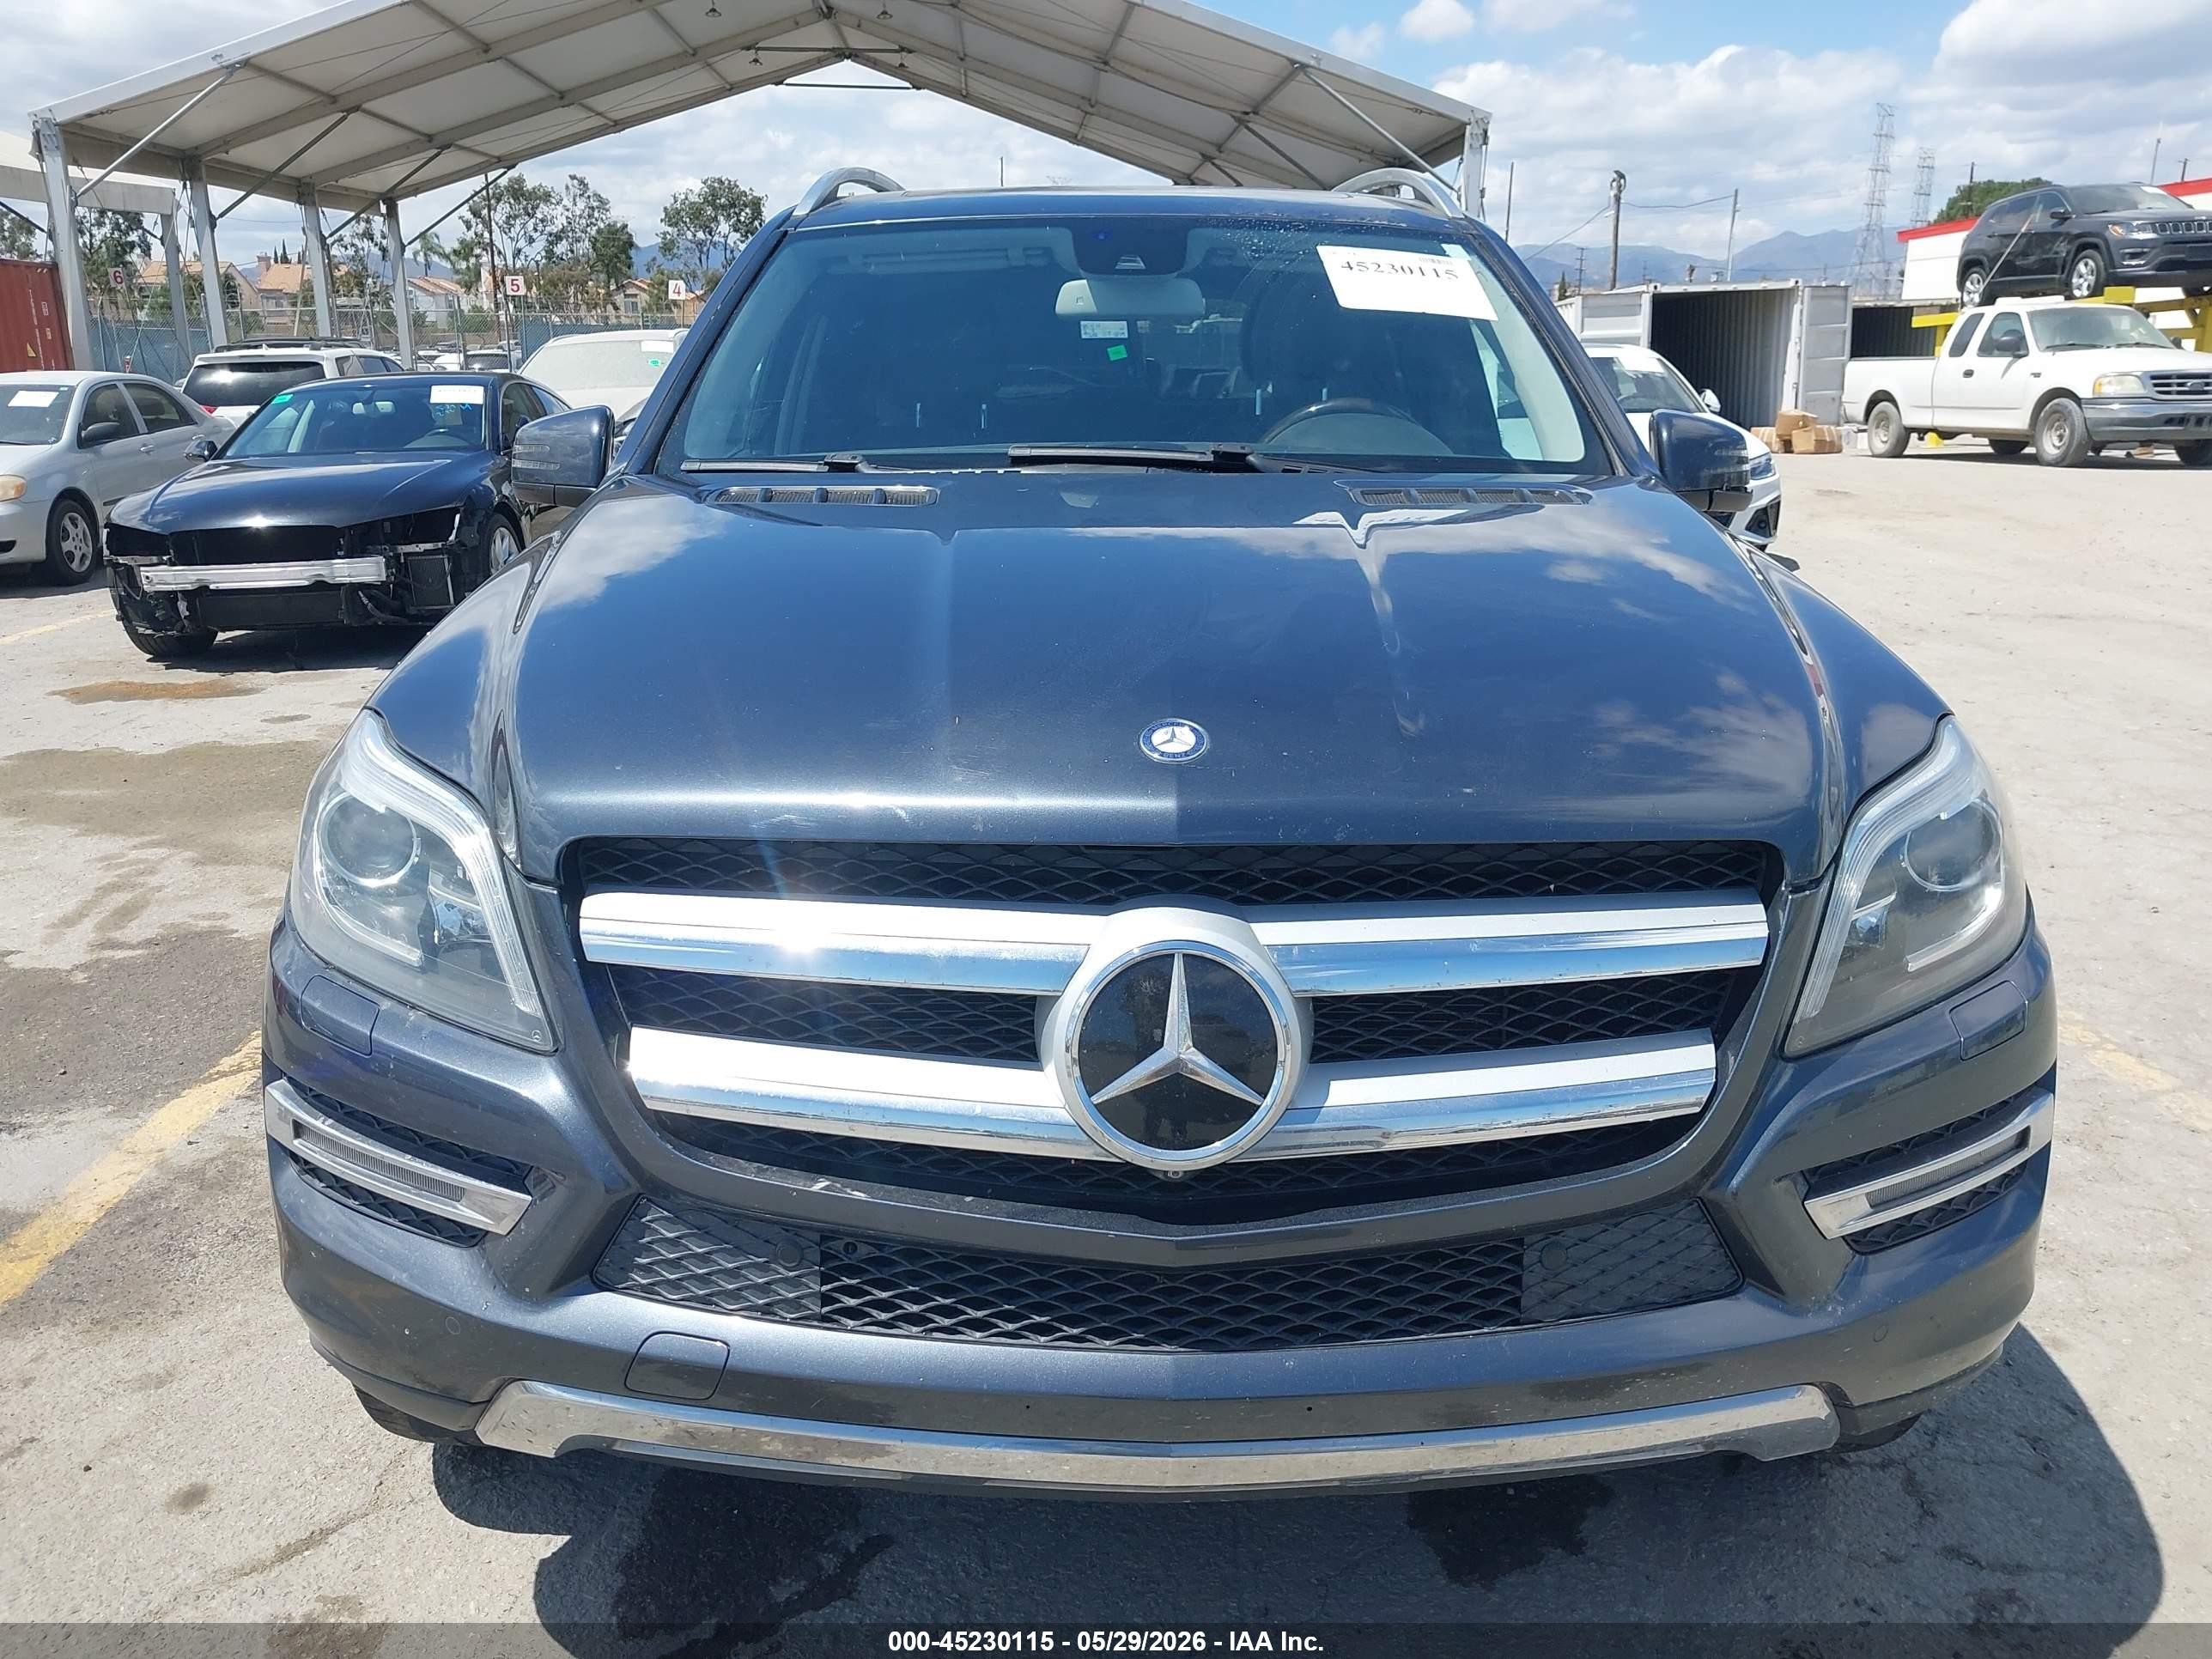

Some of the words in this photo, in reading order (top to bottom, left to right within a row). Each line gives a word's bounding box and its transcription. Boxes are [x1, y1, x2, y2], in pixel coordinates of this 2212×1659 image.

[113, 270, 124, 284] 6
[1340, 260, 1459, 280] 45230115
[510, 278, 520, 293] 5
[672, 283, 682, 297] 4
